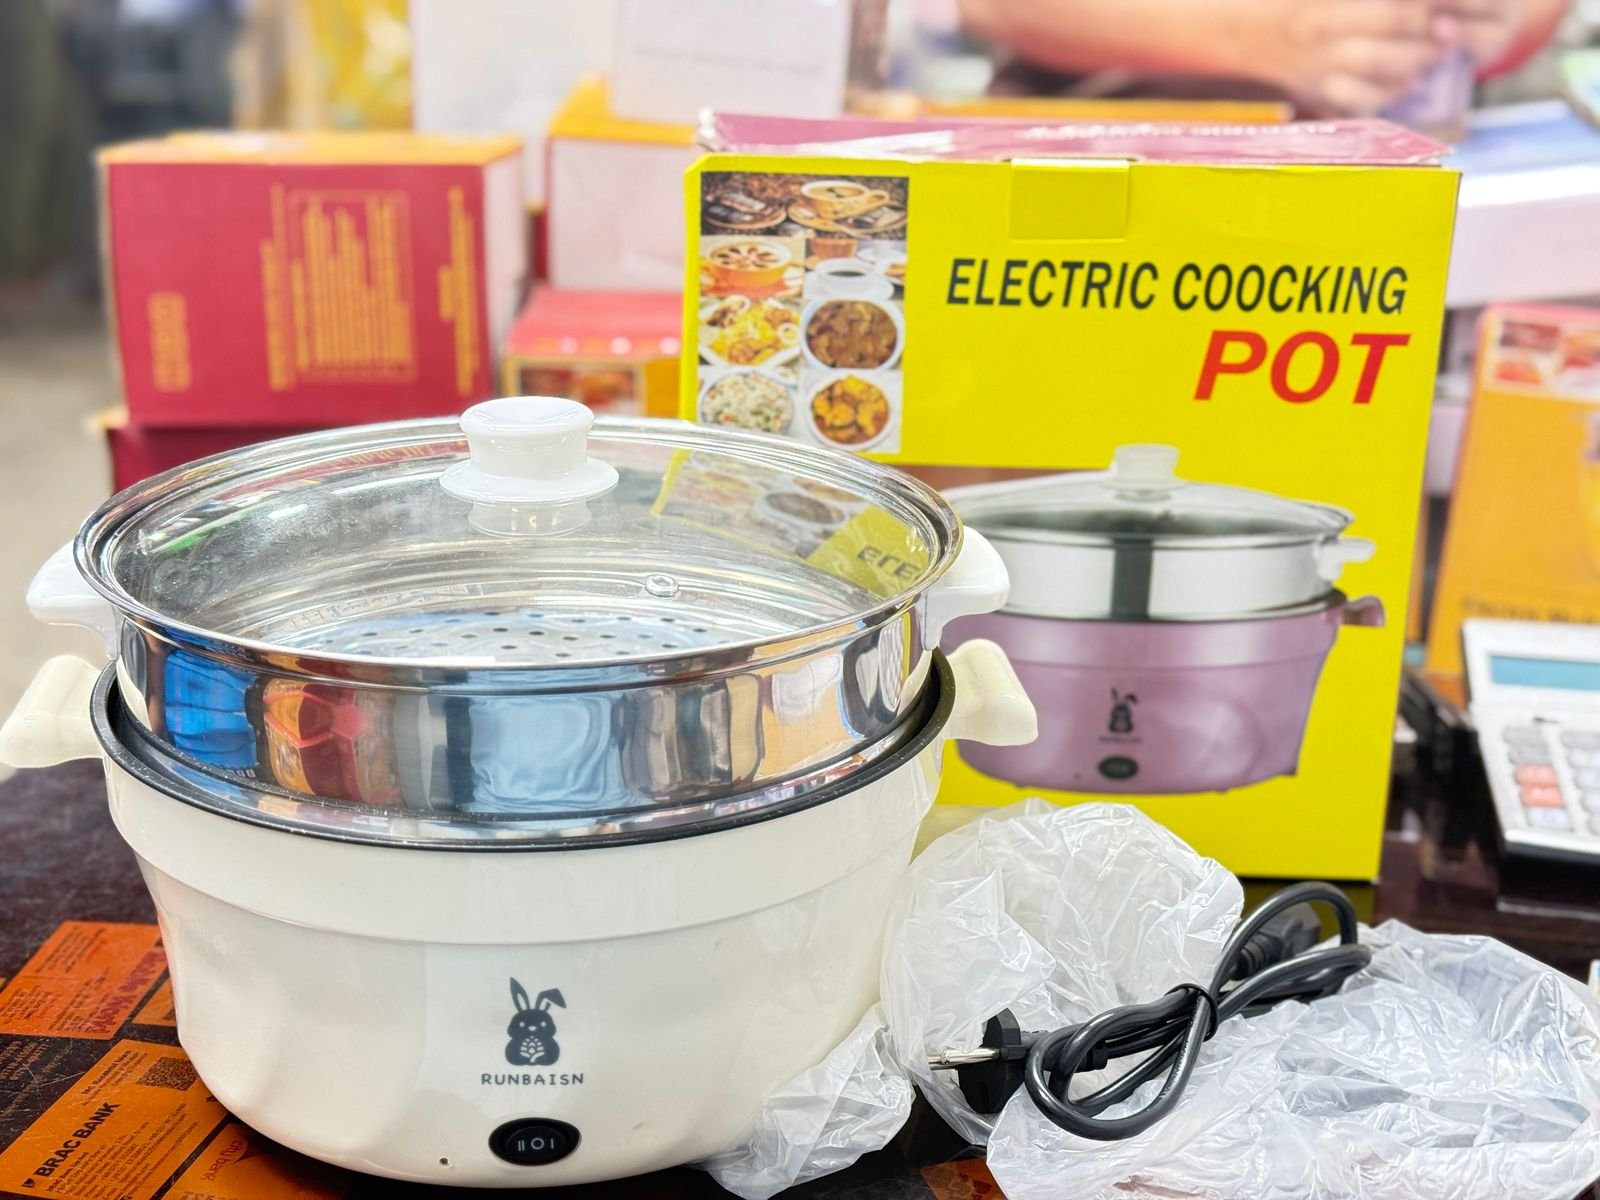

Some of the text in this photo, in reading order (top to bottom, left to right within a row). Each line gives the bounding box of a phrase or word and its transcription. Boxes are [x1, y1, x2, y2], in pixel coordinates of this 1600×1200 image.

[946, 258, 1408, 315] ELECTRIC COOCKING
[1193, 330, 1412, 404] POT
[481, 1073, 584, 1085] RUNBAISN
[33, 1138, 81, 1177] BRAC
[72, 1102, 121, 1139] BANK
